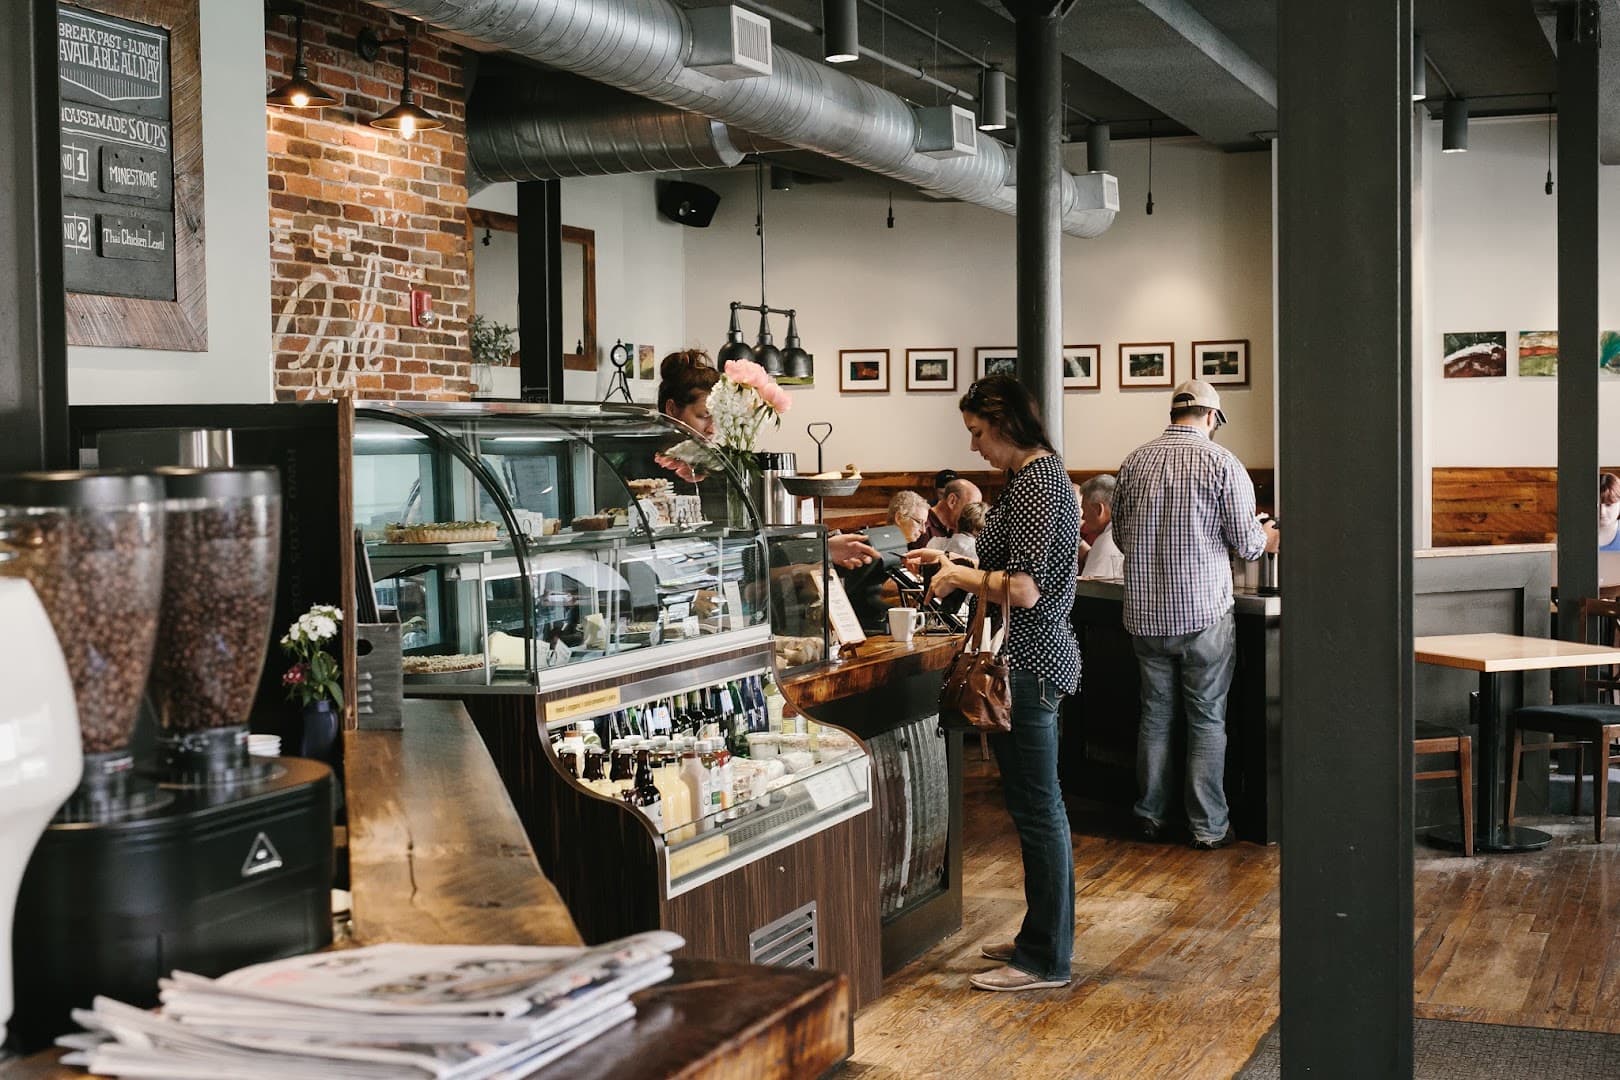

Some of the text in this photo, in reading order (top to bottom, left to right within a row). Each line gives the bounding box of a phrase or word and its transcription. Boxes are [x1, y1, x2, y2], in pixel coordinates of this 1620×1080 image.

[58, 22, 121, 50] BREAKFAST
[128, 38, 160, 60] LUNCH
[59, 39, 160, 83] AVAILABLE ALL DAY
[128, 118, 167, 148] SOUPS
[77, 152, 86, 177] 1
[109, 165, 159, 188] MINESTRONE
[64, 221, 89, 244] NO 2
[103, 227, 121, 244] Thai
[121, 228, 147, 248] Chicken
